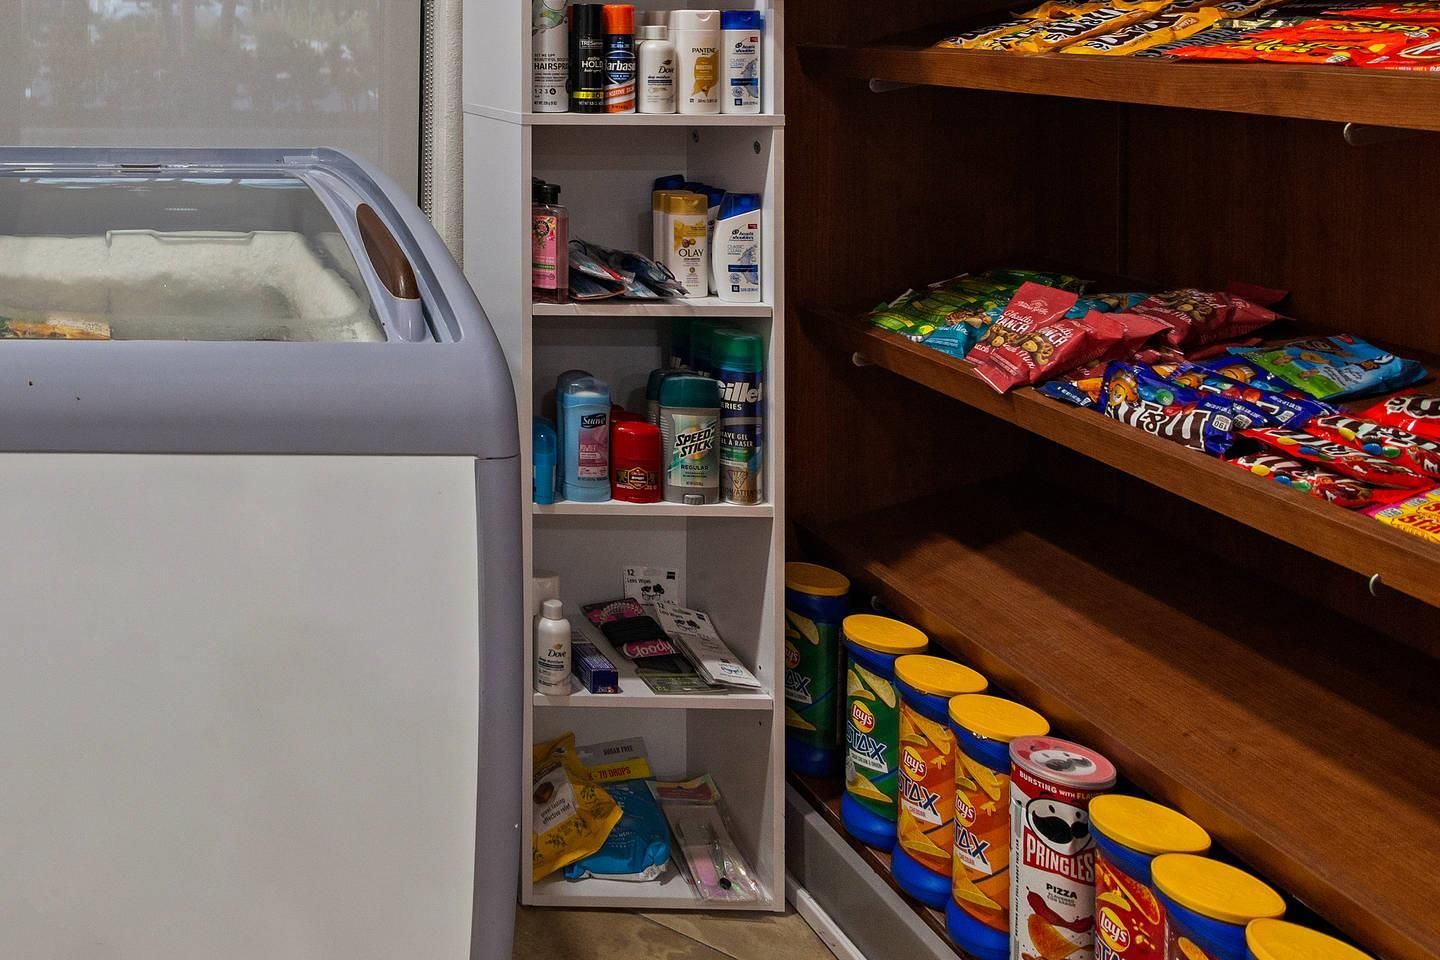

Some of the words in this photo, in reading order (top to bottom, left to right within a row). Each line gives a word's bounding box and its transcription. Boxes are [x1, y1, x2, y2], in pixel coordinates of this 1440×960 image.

[678, 248, 704, 258] OLAY
[675, 427, 711, 447] SPEED
[736, 433, 748, 441] GEL
[679, 439, 713, 458] STICK
[627, 568, 635, 577] 12
[547, 648, 567, 658] Dove
[622, 639, 674, 658] Goody
[851, 704, 875, 730] Lay's
[620, 744, 634, 753] FREE
[903, 750, 925, 774] Lay's
[608, 766, 632, 779] DROPS
[1018, 770, 1058, 795] BURSTING
[1059, 790, 1076, 799] WITH
[1025, 832, 1095, 883] PRINGLES
[1045, 882, 1078, 900] PIZZA
[1099, 913, 1128, 943] Lay's
